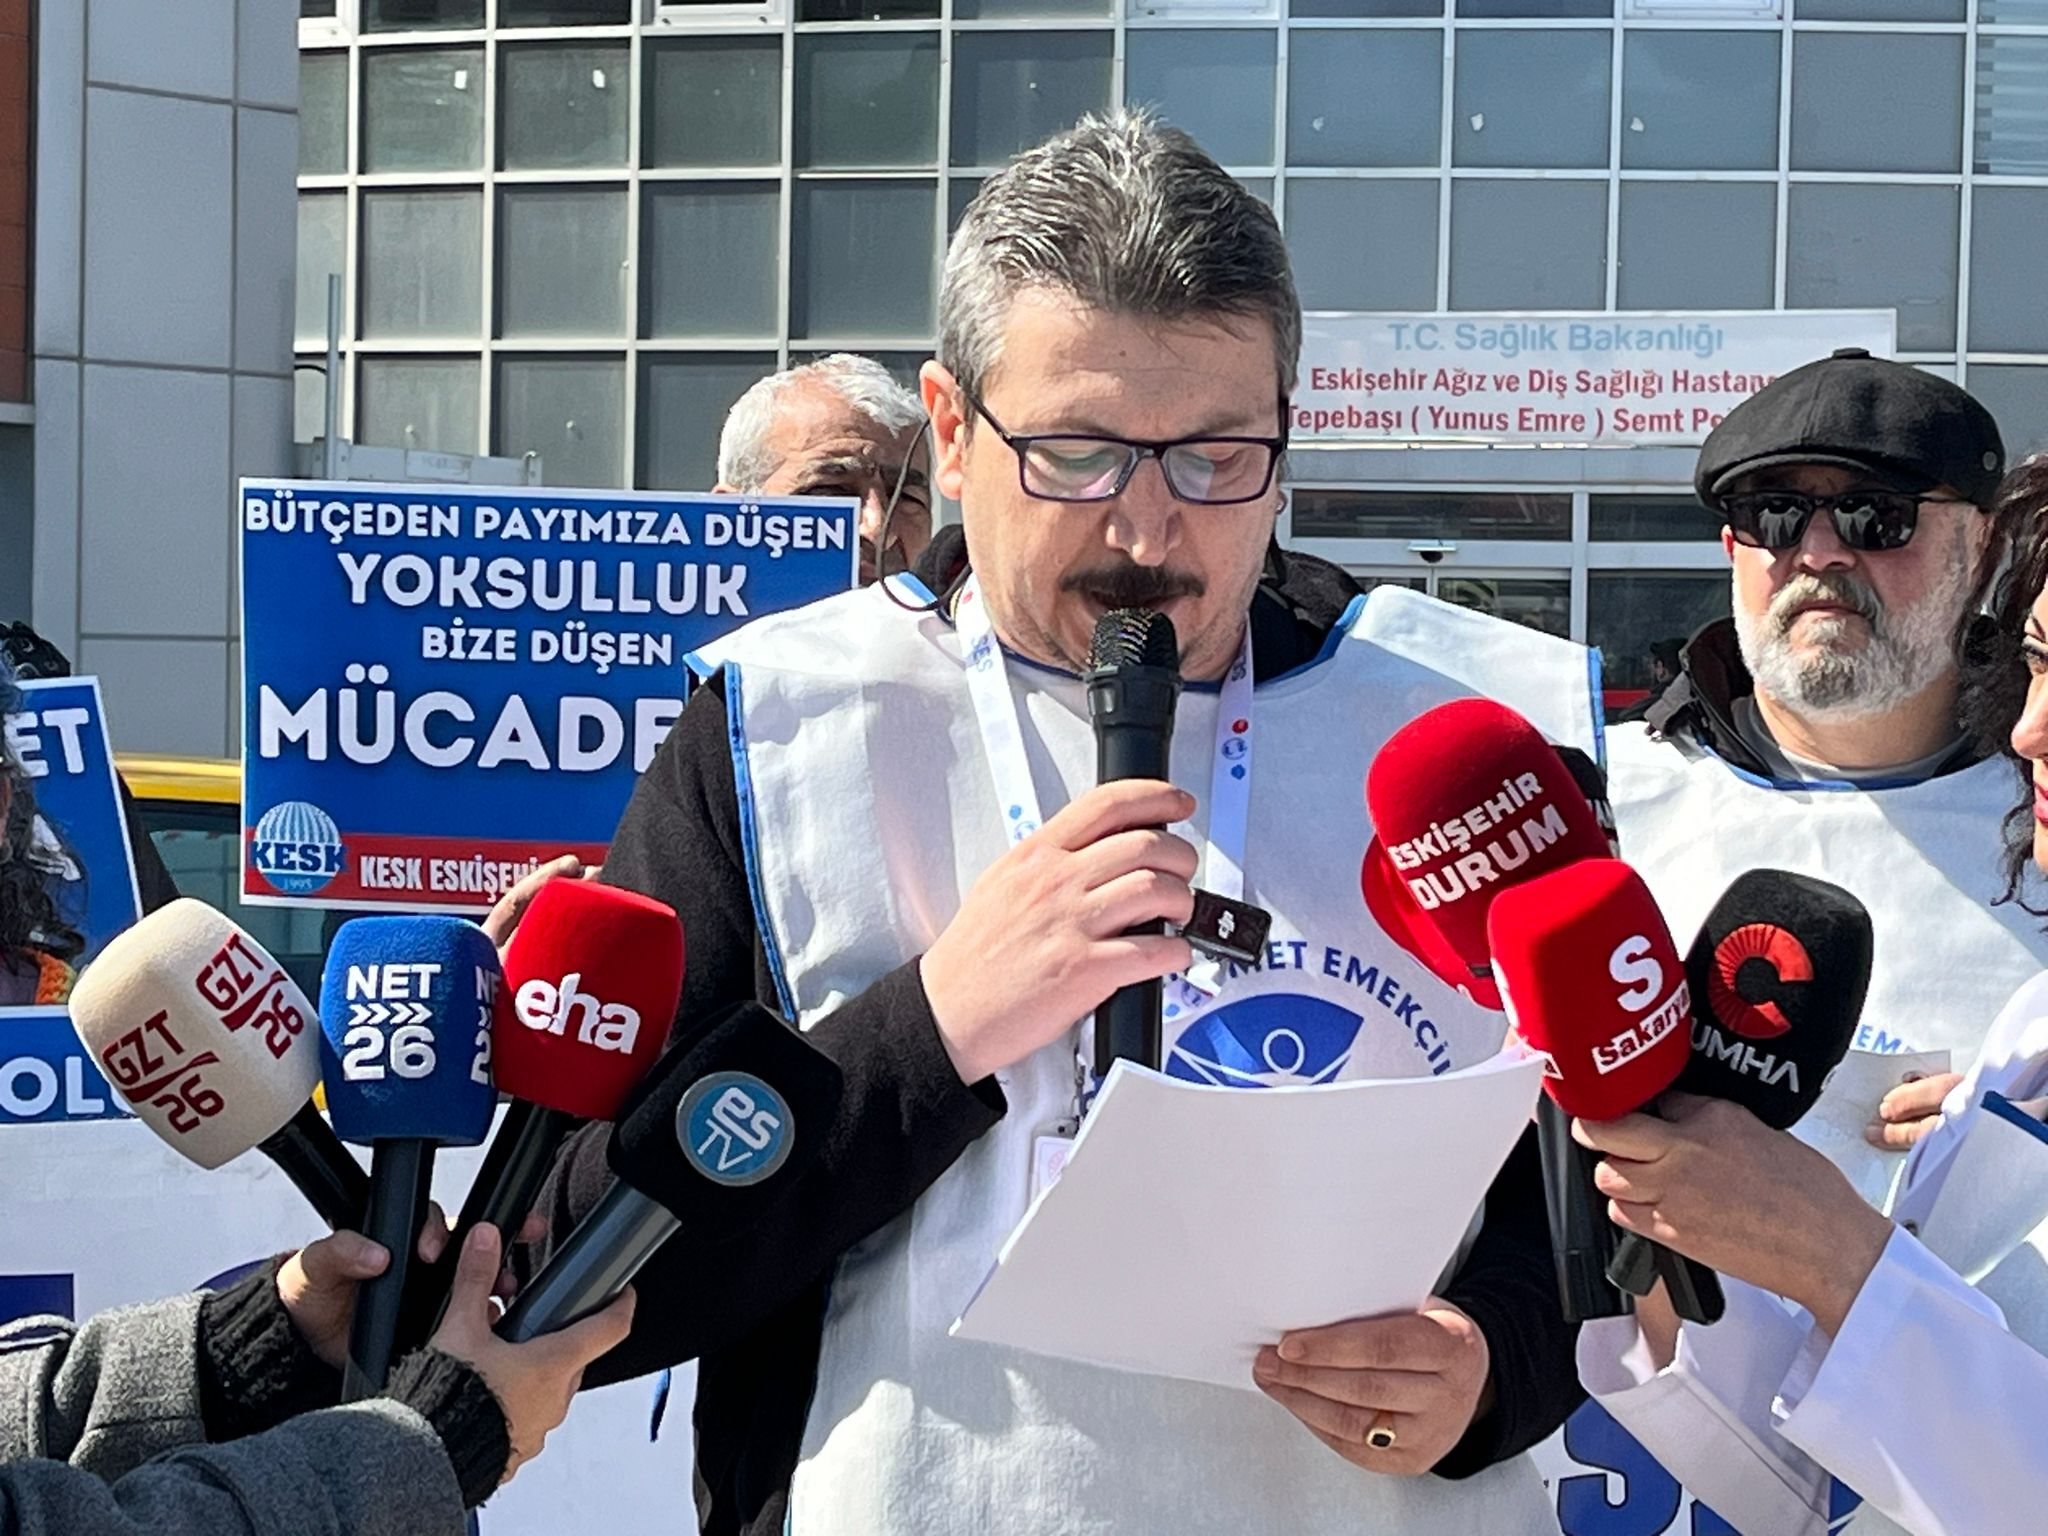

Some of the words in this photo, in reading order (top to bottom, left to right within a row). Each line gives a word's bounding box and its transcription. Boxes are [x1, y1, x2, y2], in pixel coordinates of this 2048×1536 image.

[1388, 323, 1445, 351] T.C.
[1455, 323, 1558, 359] Sağlık
[1569, 323, 1723, 359] Bakanlığı
[1311, 367, 1428, 398] Eskişehir
[1432, 367, 1487, 397] Ağız
[1493, 374, 1520, 392] ve
[1529, 369, 1568, 399] Diş
[1575, 369, 1663, 400] Sağlığı
[1428, 405, 1509, 431] Yunus
[1518, 407, 1586, 433] Emre
[1613, 408, 1684, 433] Semt
[1692, 408, 1728, 433] Po
[245, 489, 460, 545] BÜTÇEDEN
[474, 506, 692, 546] PAYIMIZA
[704, 504, 846, 559] DÜŞEN
[337, 552, 749, 617] YOKSULLUK
[422, 617, 517, 662] BİZE
[531, 620, 673, 675] DÜŞEN
[1387, 771, 1544, 871] ESKİŞEHİR
[250, 840, 348, 874] KESK
[360, 855, 424, 891] KESK
[1406, 802, 1569, 910] DURUM
[195, 932, 264, 1011] GZT
[345, 963, 442, 1001] NET
[251, 989, 304, 1060] 26
[514, 971, 641, 1055] eha
[102, 1009, 186, 1087] GZT
[342, 1024, 437, 1082] 26
[152, 1073, 225, 1135] 26
[697, 1117, 754, 1172] TV
